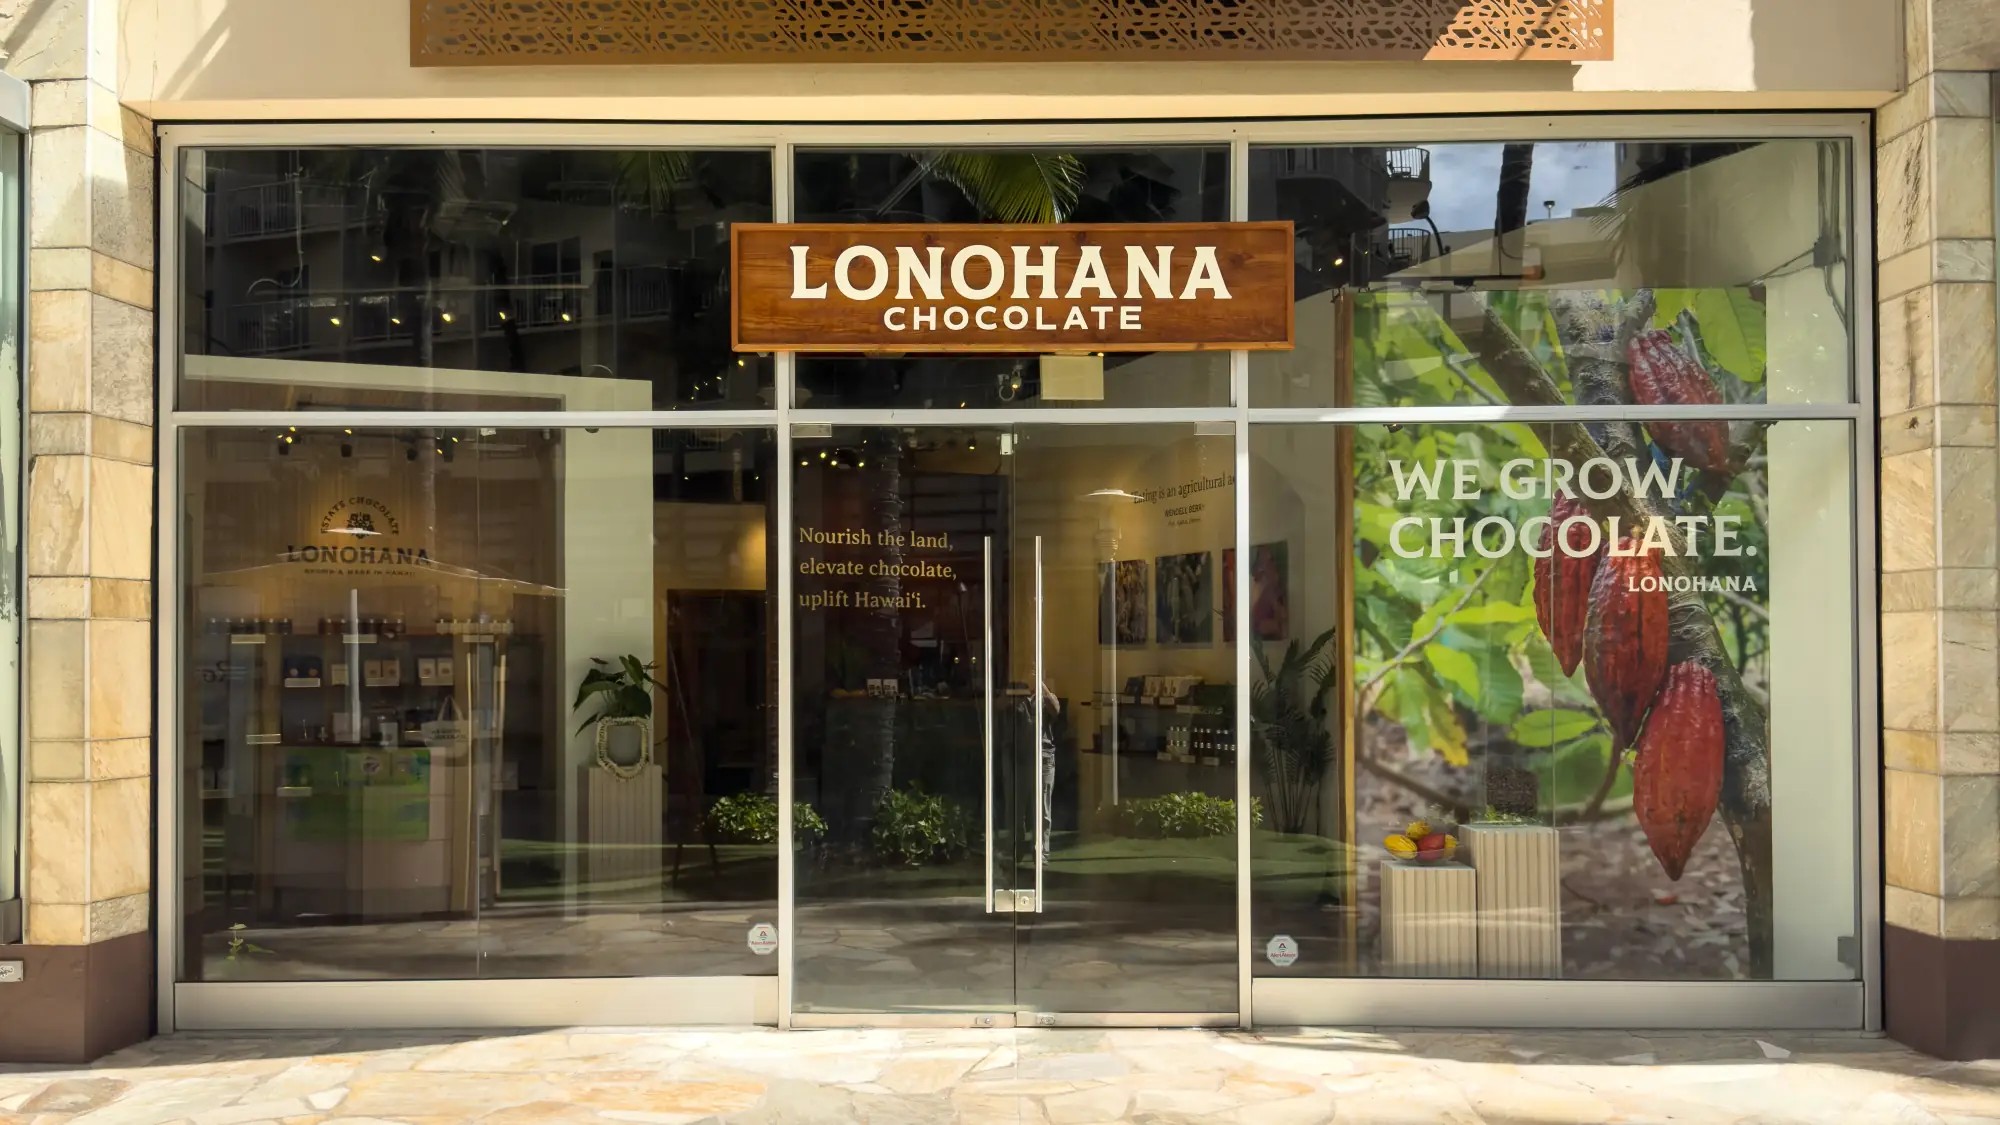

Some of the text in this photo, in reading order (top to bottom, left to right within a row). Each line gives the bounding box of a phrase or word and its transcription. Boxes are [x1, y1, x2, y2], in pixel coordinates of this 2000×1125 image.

[789, 244, 1232, 301] LONOHANA
[883, 305, 1143, 332] CHOCOLATE
[1178, 472, 1225, 498] agricultural
[1389, 457, 1684, 500] WE GROW
[320, 496, 399, 536] ESTATE CHOCOLATE
[799, 527, 954, 552] Nourish the land,
[1389, 515, 1757, 558] CHOCOLATE.
[286, 545, 431, 565] LONOHANA
[799, 557, 957, 581] elevate chocolate,
[1628, 575, 1757, 593] LONOHANA
[799, 590, 849, 611] uplift
